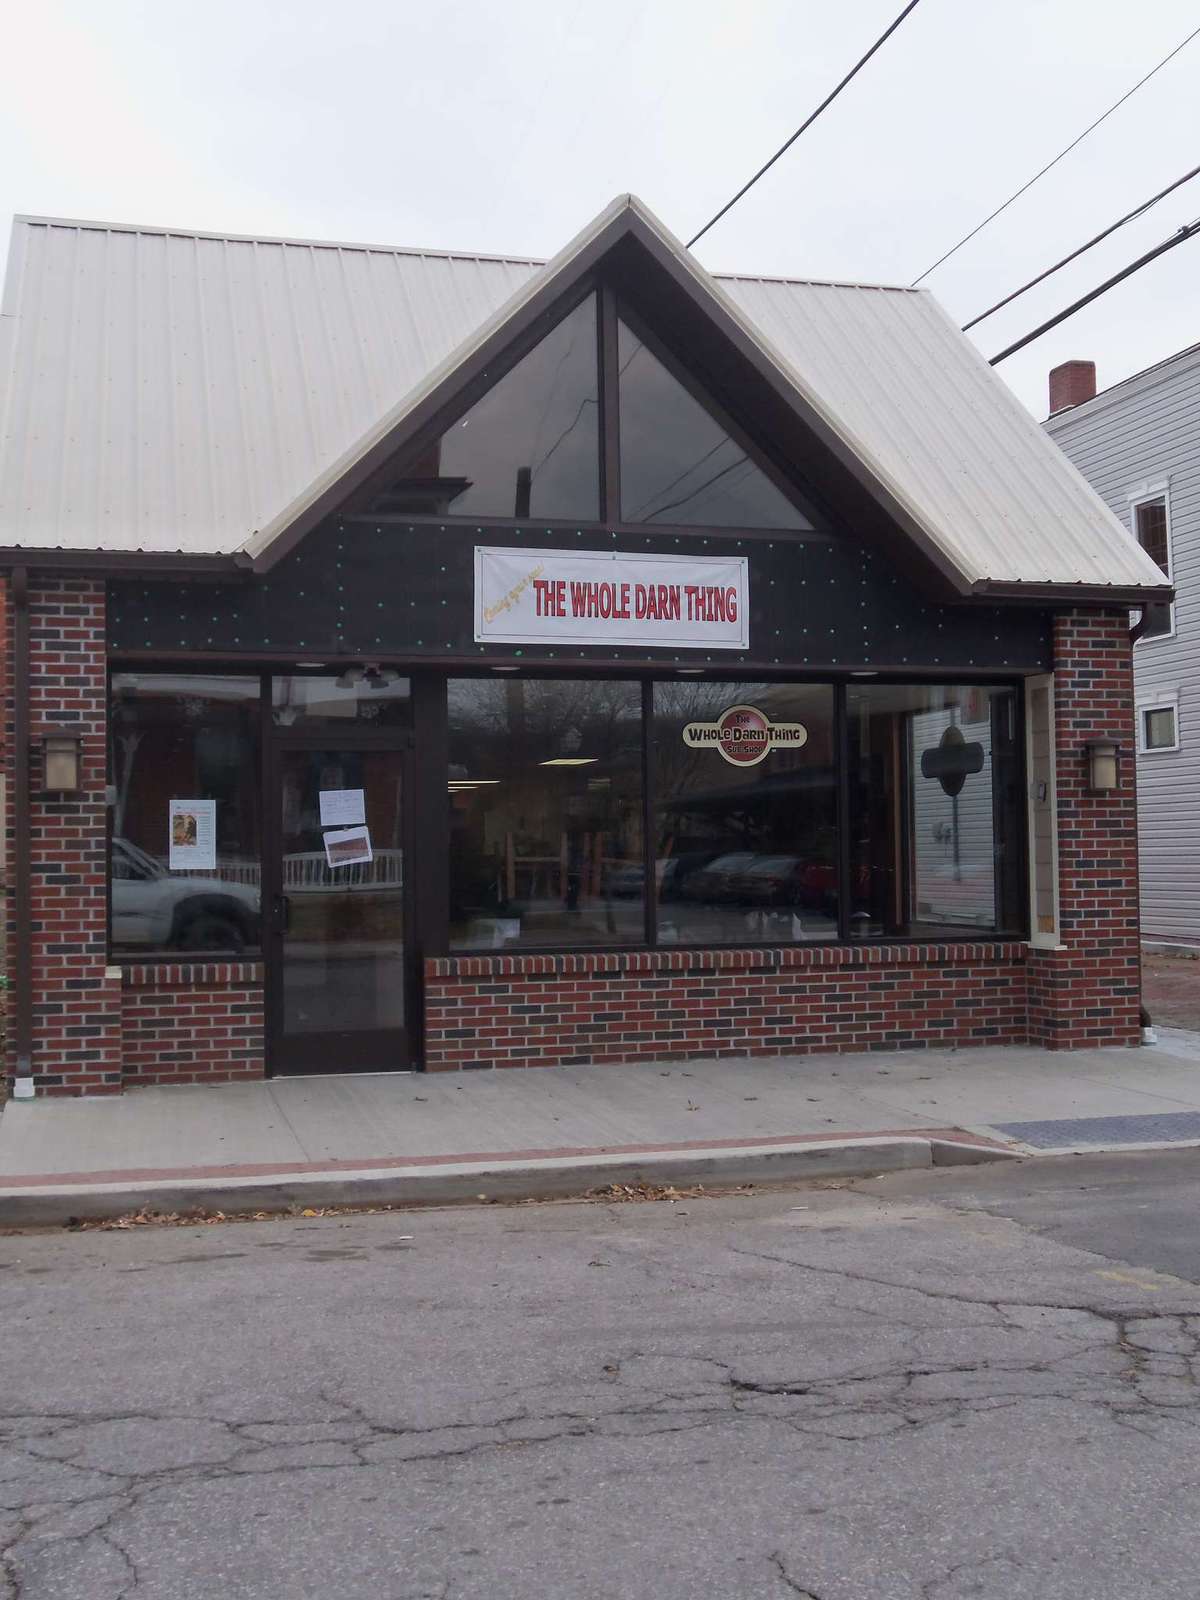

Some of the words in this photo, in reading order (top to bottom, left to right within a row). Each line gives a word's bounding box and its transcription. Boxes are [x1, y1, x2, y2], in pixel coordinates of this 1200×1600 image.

[533, 580, 567, 617] THE
[570, 581, 631, 619] WHOLE
[634, 583, 681, 621] DARN
[684, 585, 737, 623] THING
